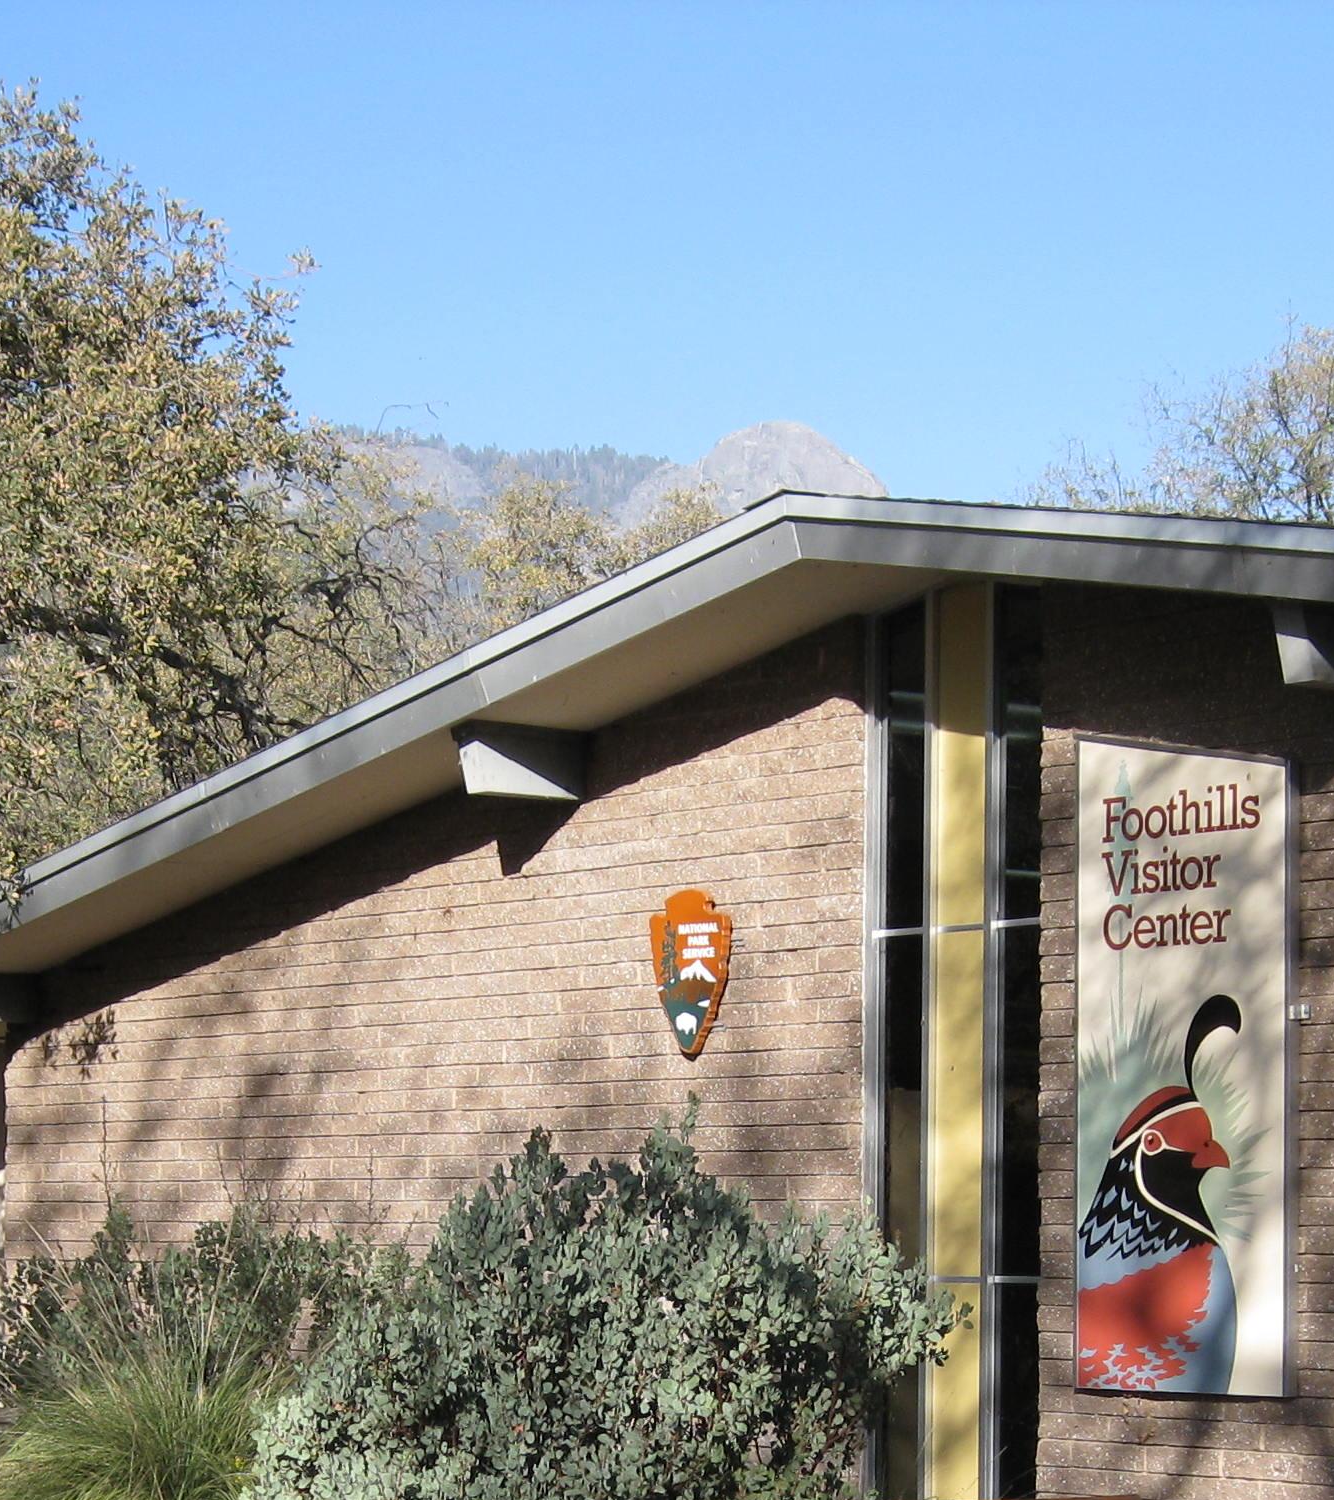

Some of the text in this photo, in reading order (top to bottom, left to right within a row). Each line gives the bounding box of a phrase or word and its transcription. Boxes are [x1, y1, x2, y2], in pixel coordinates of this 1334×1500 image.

[1101, 783, 1261, 843] Foothills
[1101, 846, 1221, 897] Visitor
[678, 922, 719, 935] NATIONAL
[687, 935, 710, 946] PARK
[1103, 903, 1232, 951] Center
[682, 947, 715, 959] SERVICE
